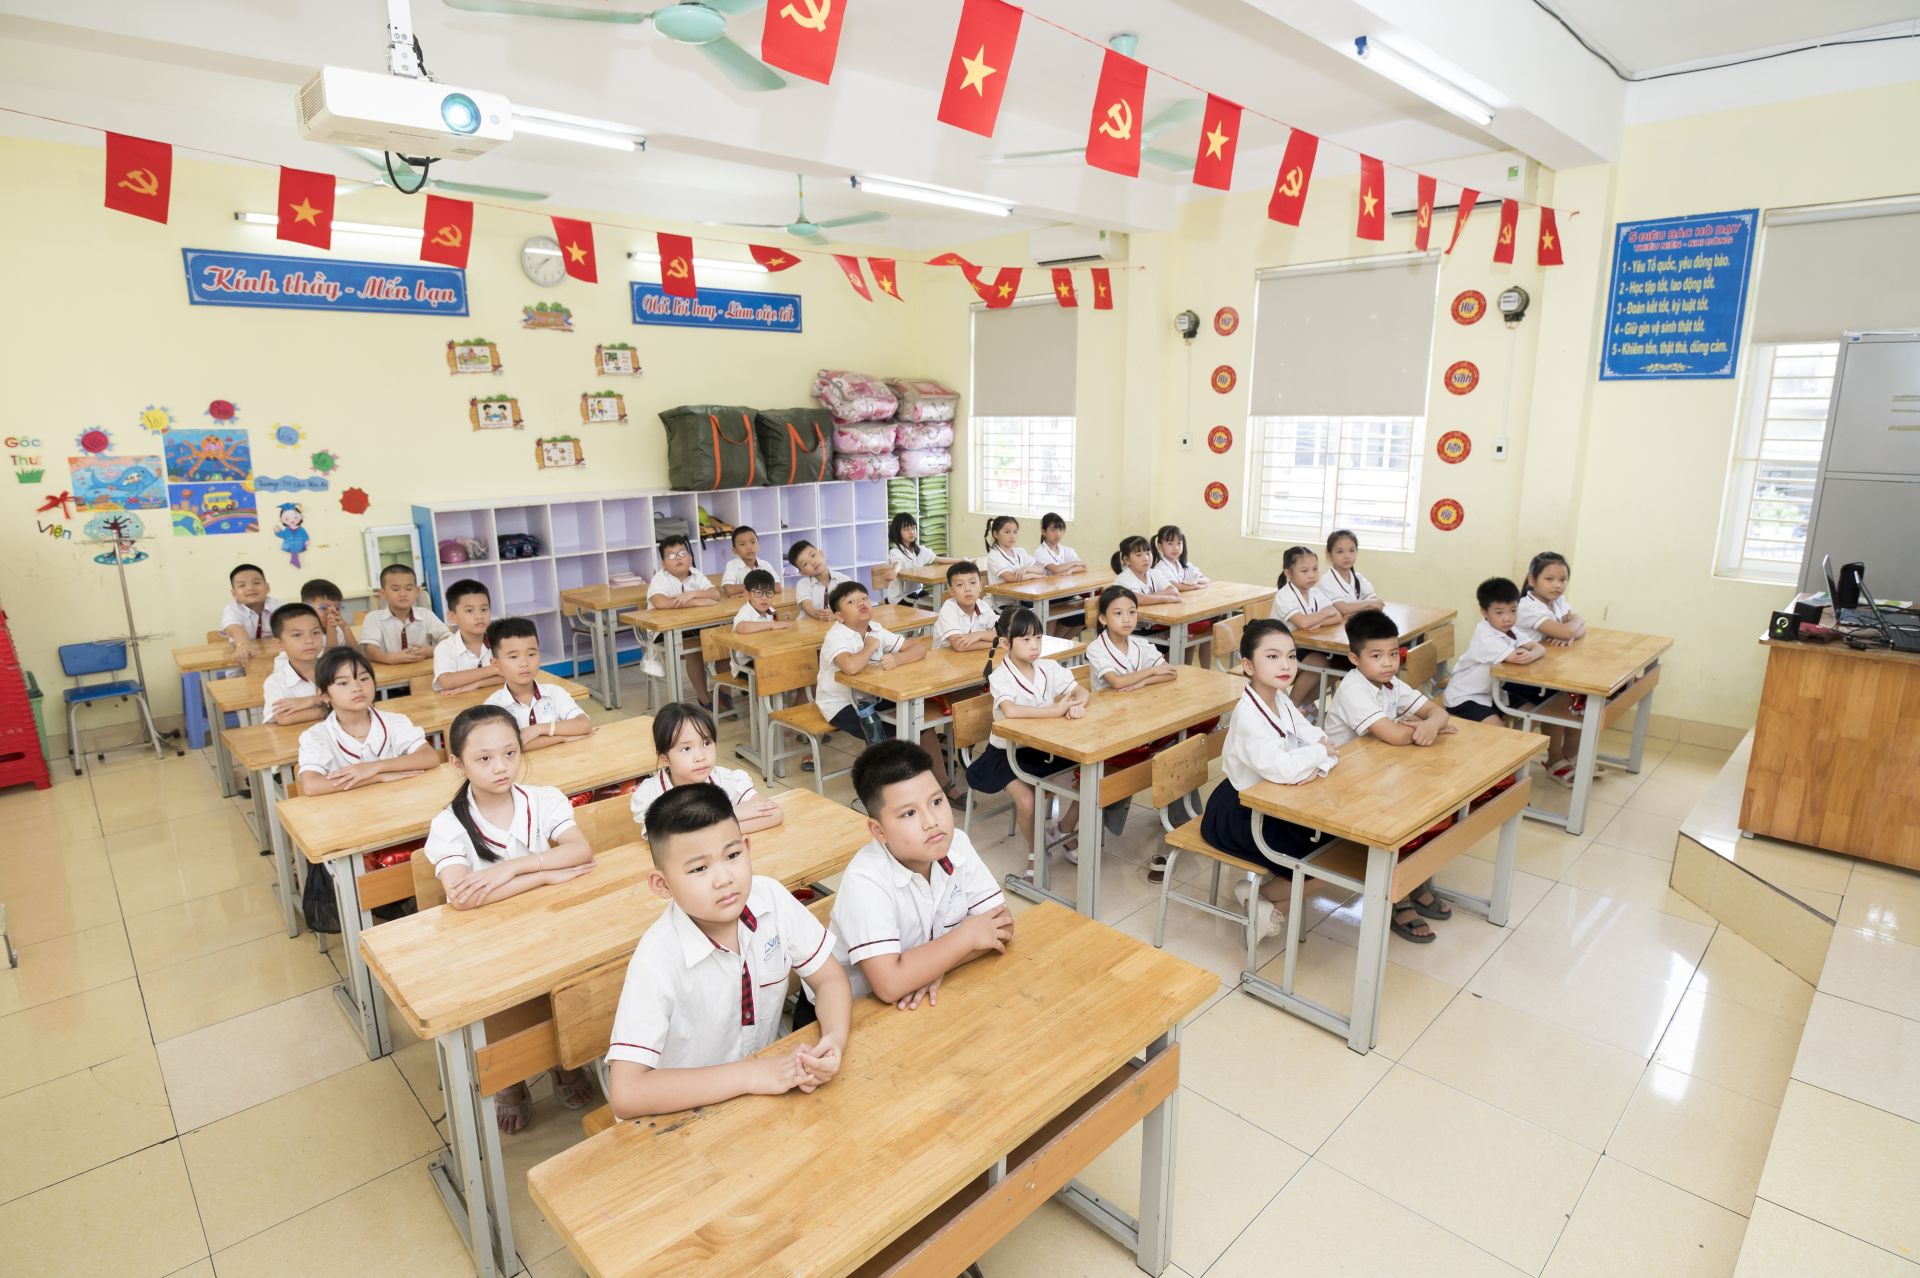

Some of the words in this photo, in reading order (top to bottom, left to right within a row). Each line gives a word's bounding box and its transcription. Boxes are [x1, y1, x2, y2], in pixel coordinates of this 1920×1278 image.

[1629, 231, 1637, 243] 5
[1668, 227, 1692, 239] BÁC
[1695, 225, 1713, 236] HỒ
[1715, 223, 1741, 236] DẠY
[1622, 261, 1627, 274] 1
[1633, 259, 1646, 273] Yêu
[1647, 256, 1656, 272] Tổ
[1657, 254, 1677, 274] quốc,
[1678, 256, 1692, 273] yêu
[1694, 252, 1712, 271] đồng
[1714, 253, 1730, 267] bào.
[202, 266, 280, 295] Kính
[284, 271, 342, 302] thầy
[358, 276, 411, 302] Mến
[415, 280, 457, 307] bạn
[1619, 281, 1625, 295] 2
[1629, 281, 1643, 296] Học
[1645, 280, 1656, 295] tập
[1657, 276, 1668, 293] tốt,
[1670, 279, 1682, 291] lao
[1683, 277, 1702, 293] động
[1703, 273, 1715, 289] tốt.
[642, 295, 670, 315] Nói
[672, 297, 691, 316] lời
[692, 298, 717, 321] hay
[725, 301, 753, 319] Làm
[756, 304, 777, 326] việc
[779, 304, 794, 322] tốt
[1461, 301, 1475, 312] Học
[1617, 302, 1622, 315] 3
[1627, 301, 1645, 314] Đoàn
[1658, 297, 1670, 315] tốt,
[1682, 298, 1696, 314] luật
[1697, 295, 1709, 311] tốt.
[1614, 323, 1620, 335] 4
[1624, 322, 1638, 335] Giữ
[1651, 321, 1660, 336] vệ
[1661, 320, 1677, 333] sinh
[1678, 320, 1692, 335] thật
[1693, 316, 1705, 332] tốt.
[1612, 343, 1617, 356] 5
[1622, 342, 1644, 355] Khiêm
[1660, 340, 1674, 357] thật
[1690, 340, 1709, 356] dũng
[1710, 339, 1728, 353] cảm.
[1453, 372, 1472, 383] Sinh
